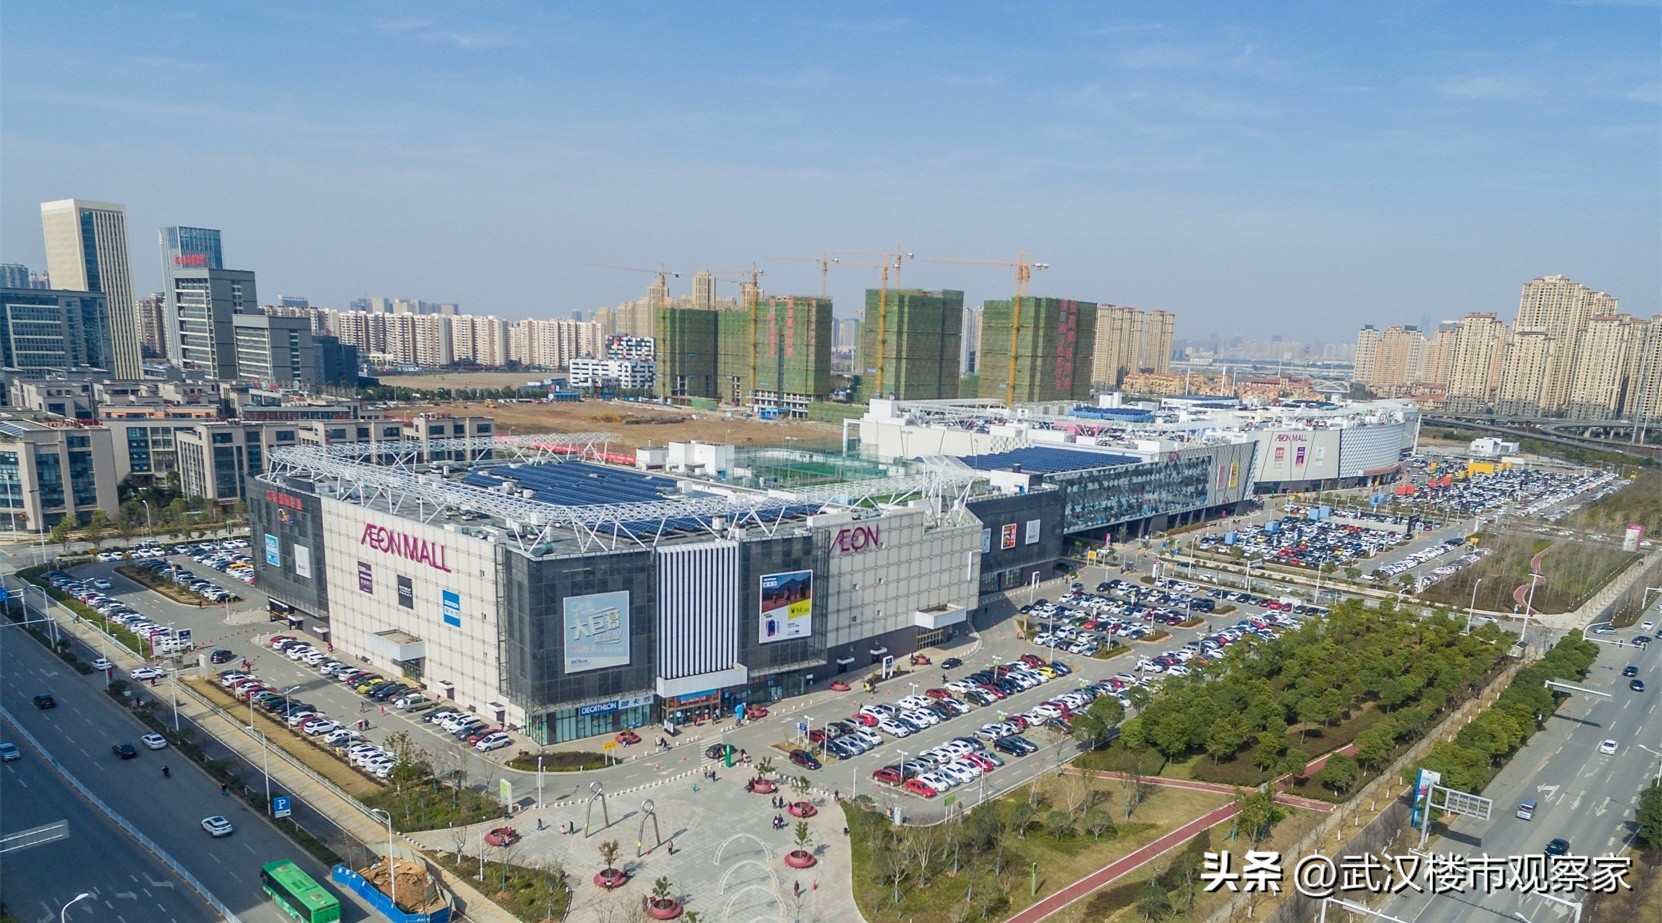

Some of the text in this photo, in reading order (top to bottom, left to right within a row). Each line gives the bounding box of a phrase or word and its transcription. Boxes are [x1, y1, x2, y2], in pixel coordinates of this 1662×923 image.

[402, 533, 452, 573] MALL
[582, 703, 616, 714] DECATHLON
[278, 799, 286, 809] P
